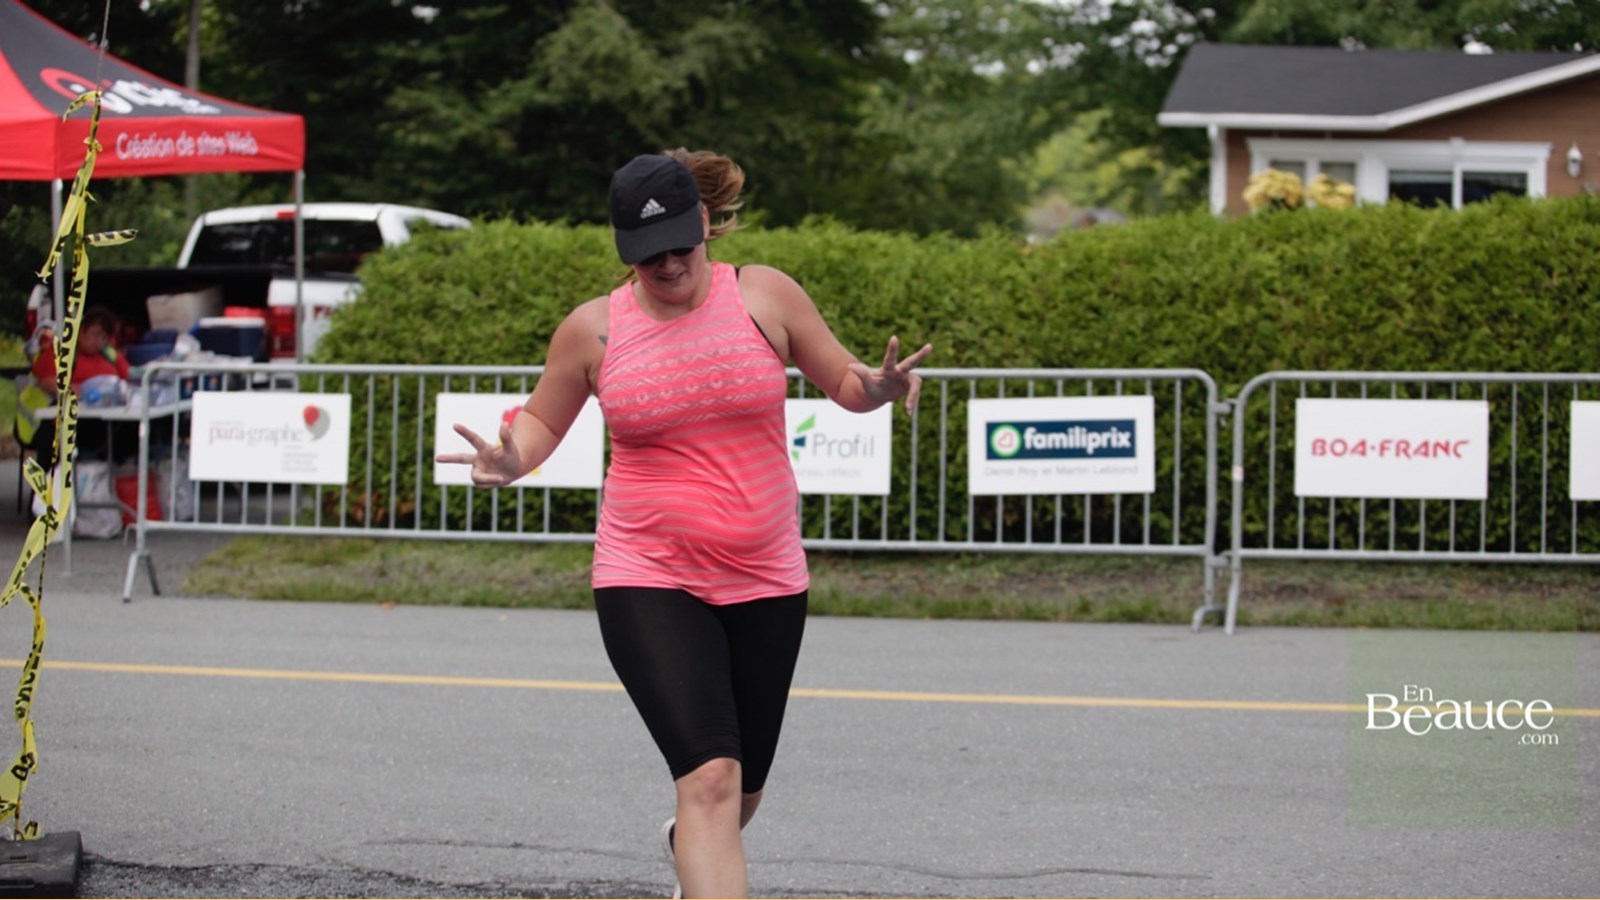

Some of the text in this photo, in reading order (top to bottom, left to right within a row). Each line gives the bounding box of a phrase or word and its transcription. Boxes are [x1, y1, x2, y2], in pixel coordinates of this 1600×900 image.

[116, 132, 175, 160] Création
[176, 131, 195, 157] de
[812, 433, 875, 458] Profil
[1023, 425, 1132, 455] familiprix
[1056, 464, 1089, 475] Martin
